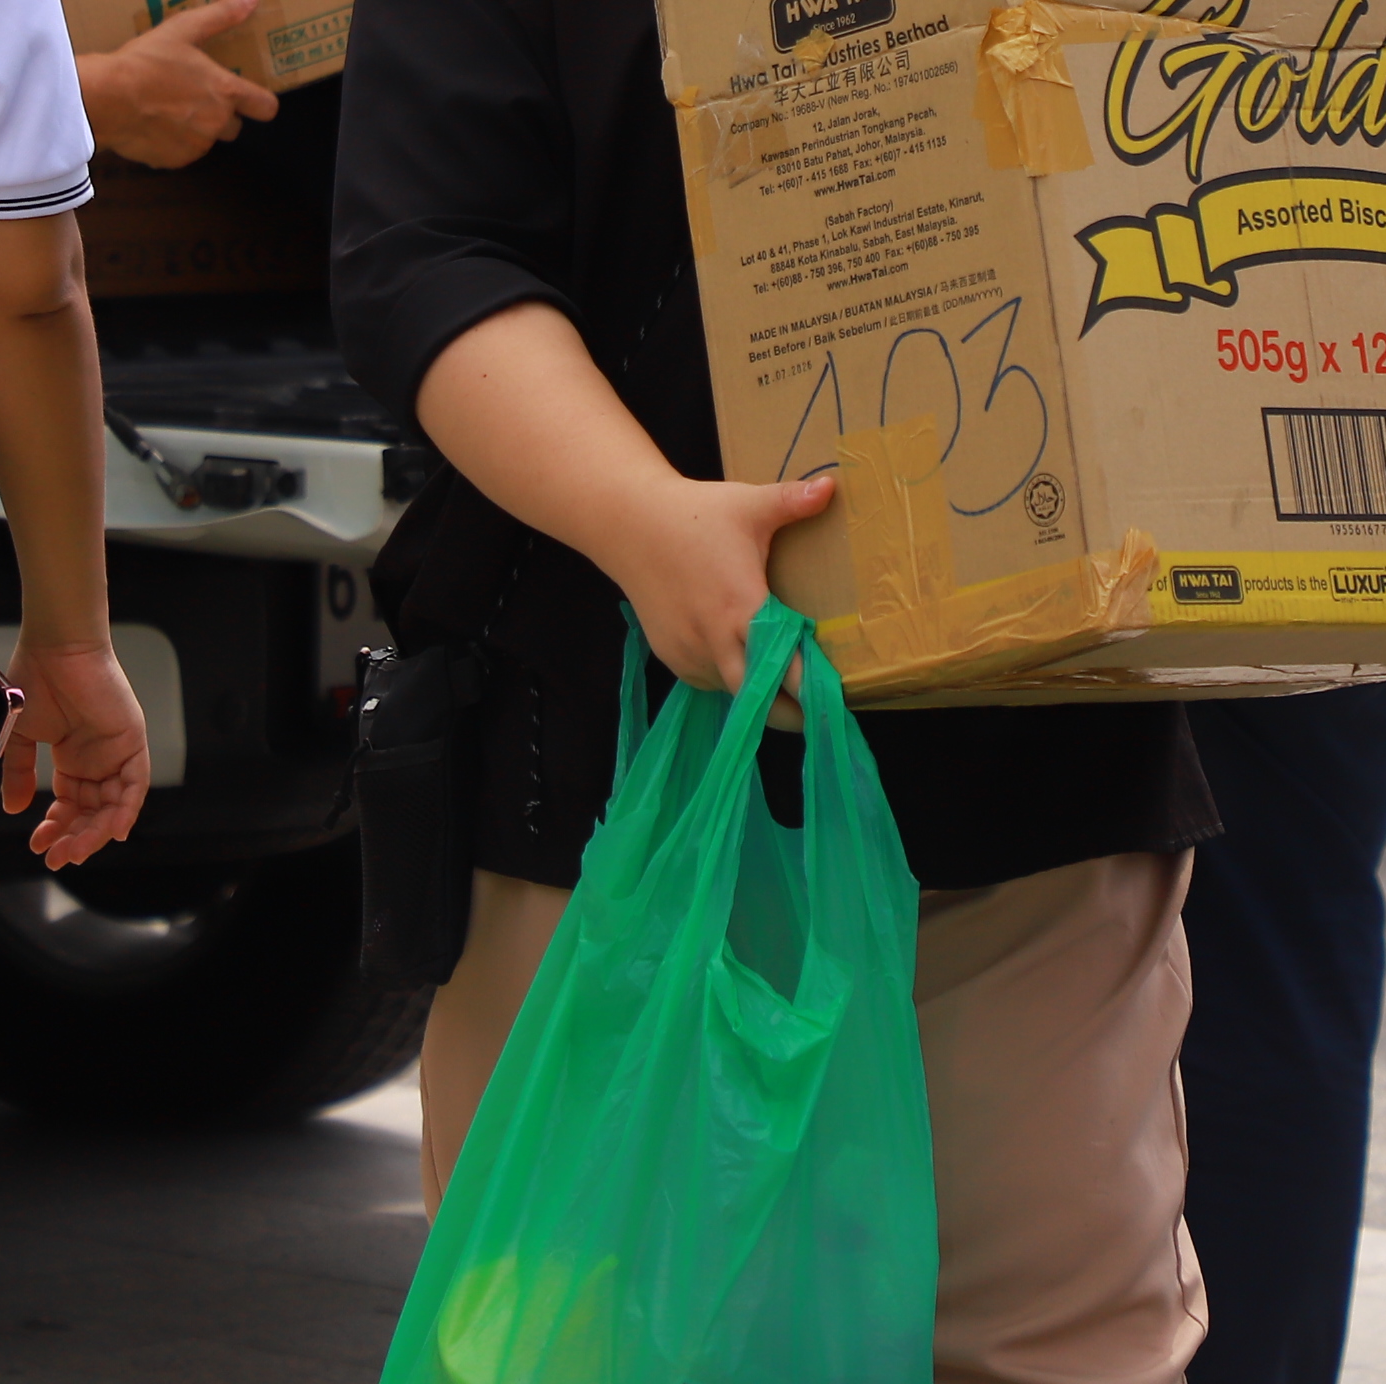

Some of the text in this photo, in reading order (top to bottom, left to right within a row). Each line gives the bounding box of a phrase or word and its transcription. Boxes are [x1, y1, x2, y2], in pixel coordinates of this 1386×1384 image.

[836, 13, 857, 28] 1962
[730, 71, 769, 95] Hwa
[771, 58, 797, 82] Tai
[885, 14, 950, 49] Berhad
[774, 49, 911, 106] 华大工业有限公司
[730, 116, 770, 135] Company
[827, 93, 850, 109] (New
[851, 87, 872, 101] Reg.
[874, 81, 892, 95] No.:
[813, 106, 881, 133] 12, Jalan Jorak,
[760, 107, 938, 165] Kawasan Perindustrian Tongkang Pecah,
[776, 126, 926, 176] 83010 Batu Pahat, Johor, Malaysia.
[759, 183, 775, 197] Tel:
[777, 174, 804, 193] +(60)7
[810, 169, 827, 184] 415
[853, 157, 873, 171] Fax:
[875, 147, 901, 165] +(60)7
[909, 142, 926, 155] 415
[927, 135, 948, 150] 1135
[813, 166, 897, 198] www.HwaTai.com
[740, 191, 985, 267] Lot 40 & 41, Phase 1, Lok Kawi Industrial Estate, Kinarut,
[797, 253, 819, 266] Kota
[819, 243, 861, 261] Kinabalu,
[862, 233, 893, 249] Sabah,
[895, 227, 915, 241] East
[916, 215, 958, 233] Malaysia.
[825, 199, 894, 229] (Sabah Factory)
[1236, 198, 1334, 236] Assorted
[753, 282, 769, 295] Tel:
[771, 272, 803, 291] +(60)88
[810, 266, 826, 279] 750
[827, 261, 846, 275] 396,
[847, 256, 863, 270] 750
[865, 251, 881, 264] 400
[885, 246, 904, 259] Fax:
[906, 235, 939, 255] +(60)88
[946, 228, 962, 243] 750
[964, 224, 980, 238] 395
[826, 261, 909, 291] www.HwaTai.com
[748, 348, 772, 364] Best
[773, 341, 806, 357] Before
[814, 332, 837, 346] Baik
[838, 320, 882, 340] Sebelum
[942, 285, 1004, 313] (DD/MM/YYYY)
[749, 327, 777, 344] MADE
[779, 324, 789, 336] IN
[790, 311, 839, 334] MALAYSIA
[845, 298, 883, 319] BUATAN
[884, 286, 934, 307] MALAYSIA
[1216, 328, 1309, 384] 505g
[1321, 339, 1342, 374] x
[1156, 575, 1168, 591] of
[1179, 573, 1211, 588] HWA
[1211, 573, 1233, 588] TAI
[1244, 576, 1294, 594] products
[1297, 575, 1307, 592] is
[1310, 576, 1328, 591] the
